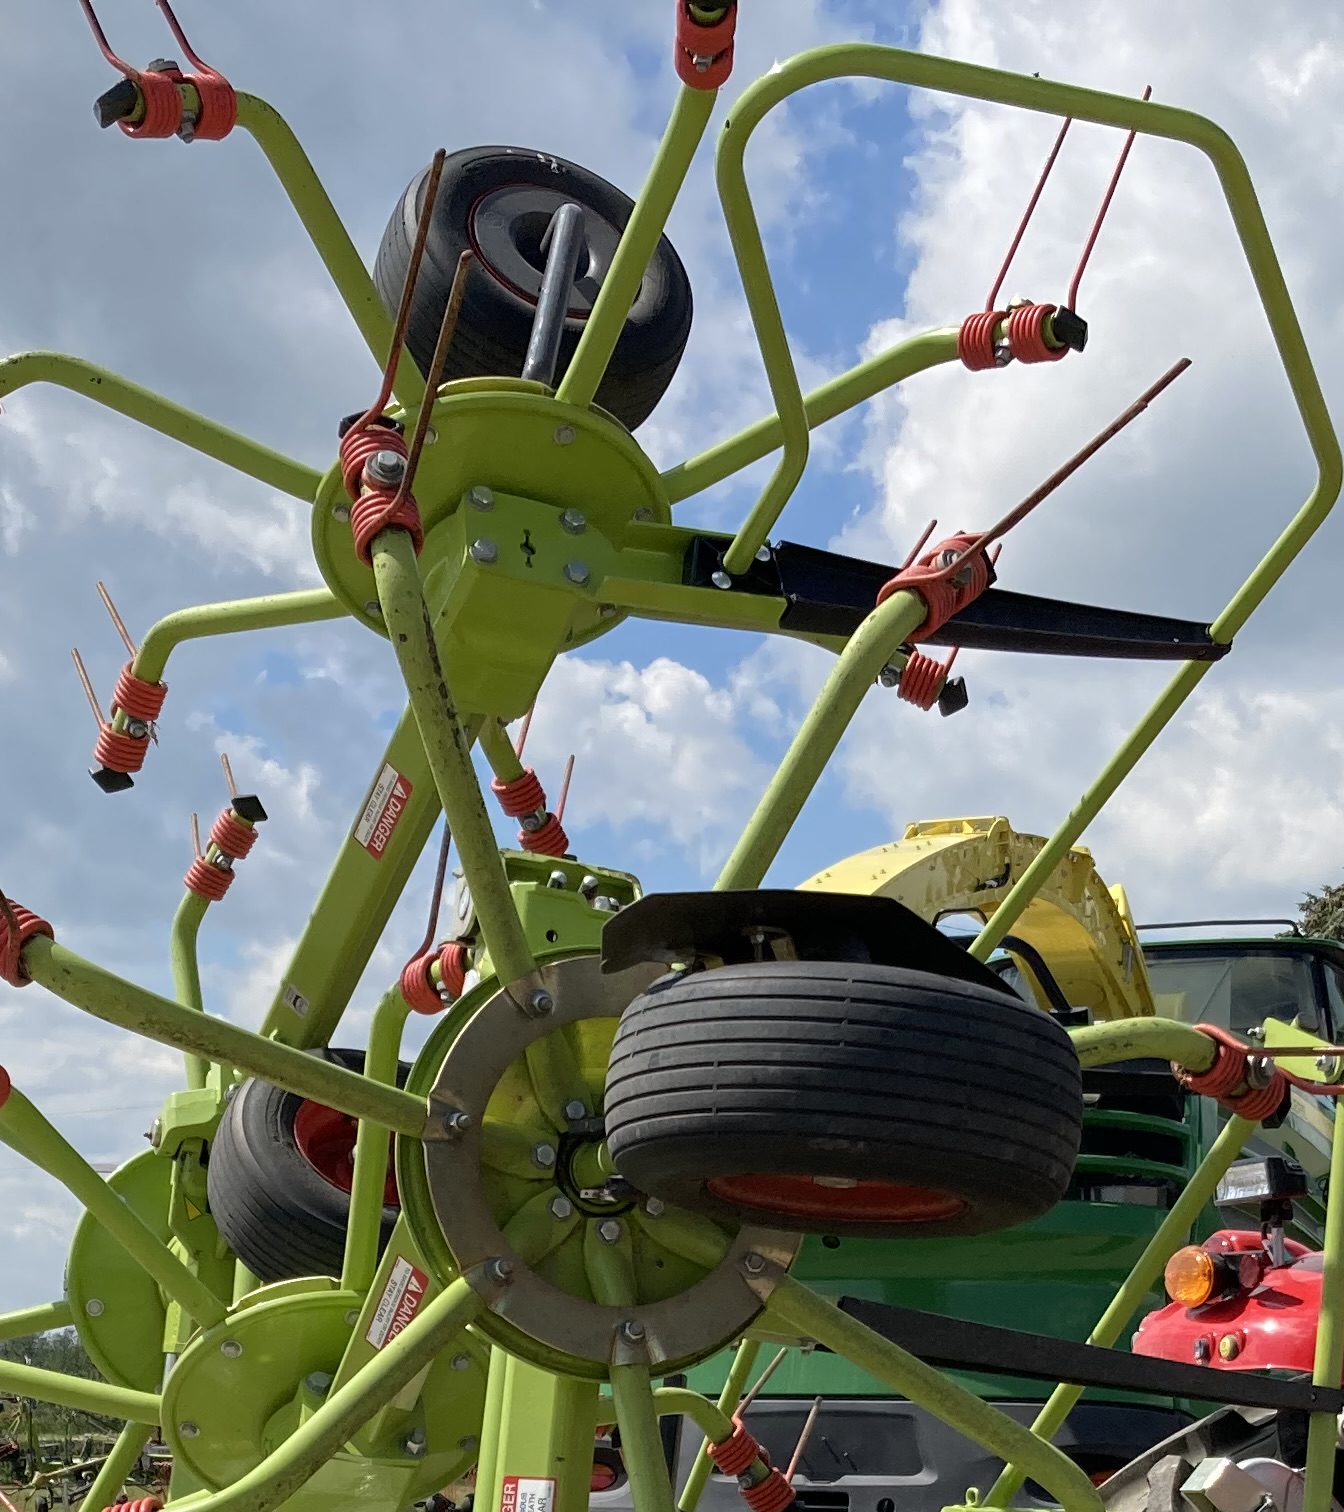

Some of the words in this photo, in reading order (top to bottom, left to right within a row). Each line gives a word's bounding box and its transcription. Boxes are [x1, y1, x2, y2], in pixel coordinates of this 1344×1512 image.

[370, 797, 401, 852] DANGER
[386, 1279, 398, 1298] STAY
[376, 1298, 390, 1324] CLEAR
[387, 1293, 417, 1341] DANGE
